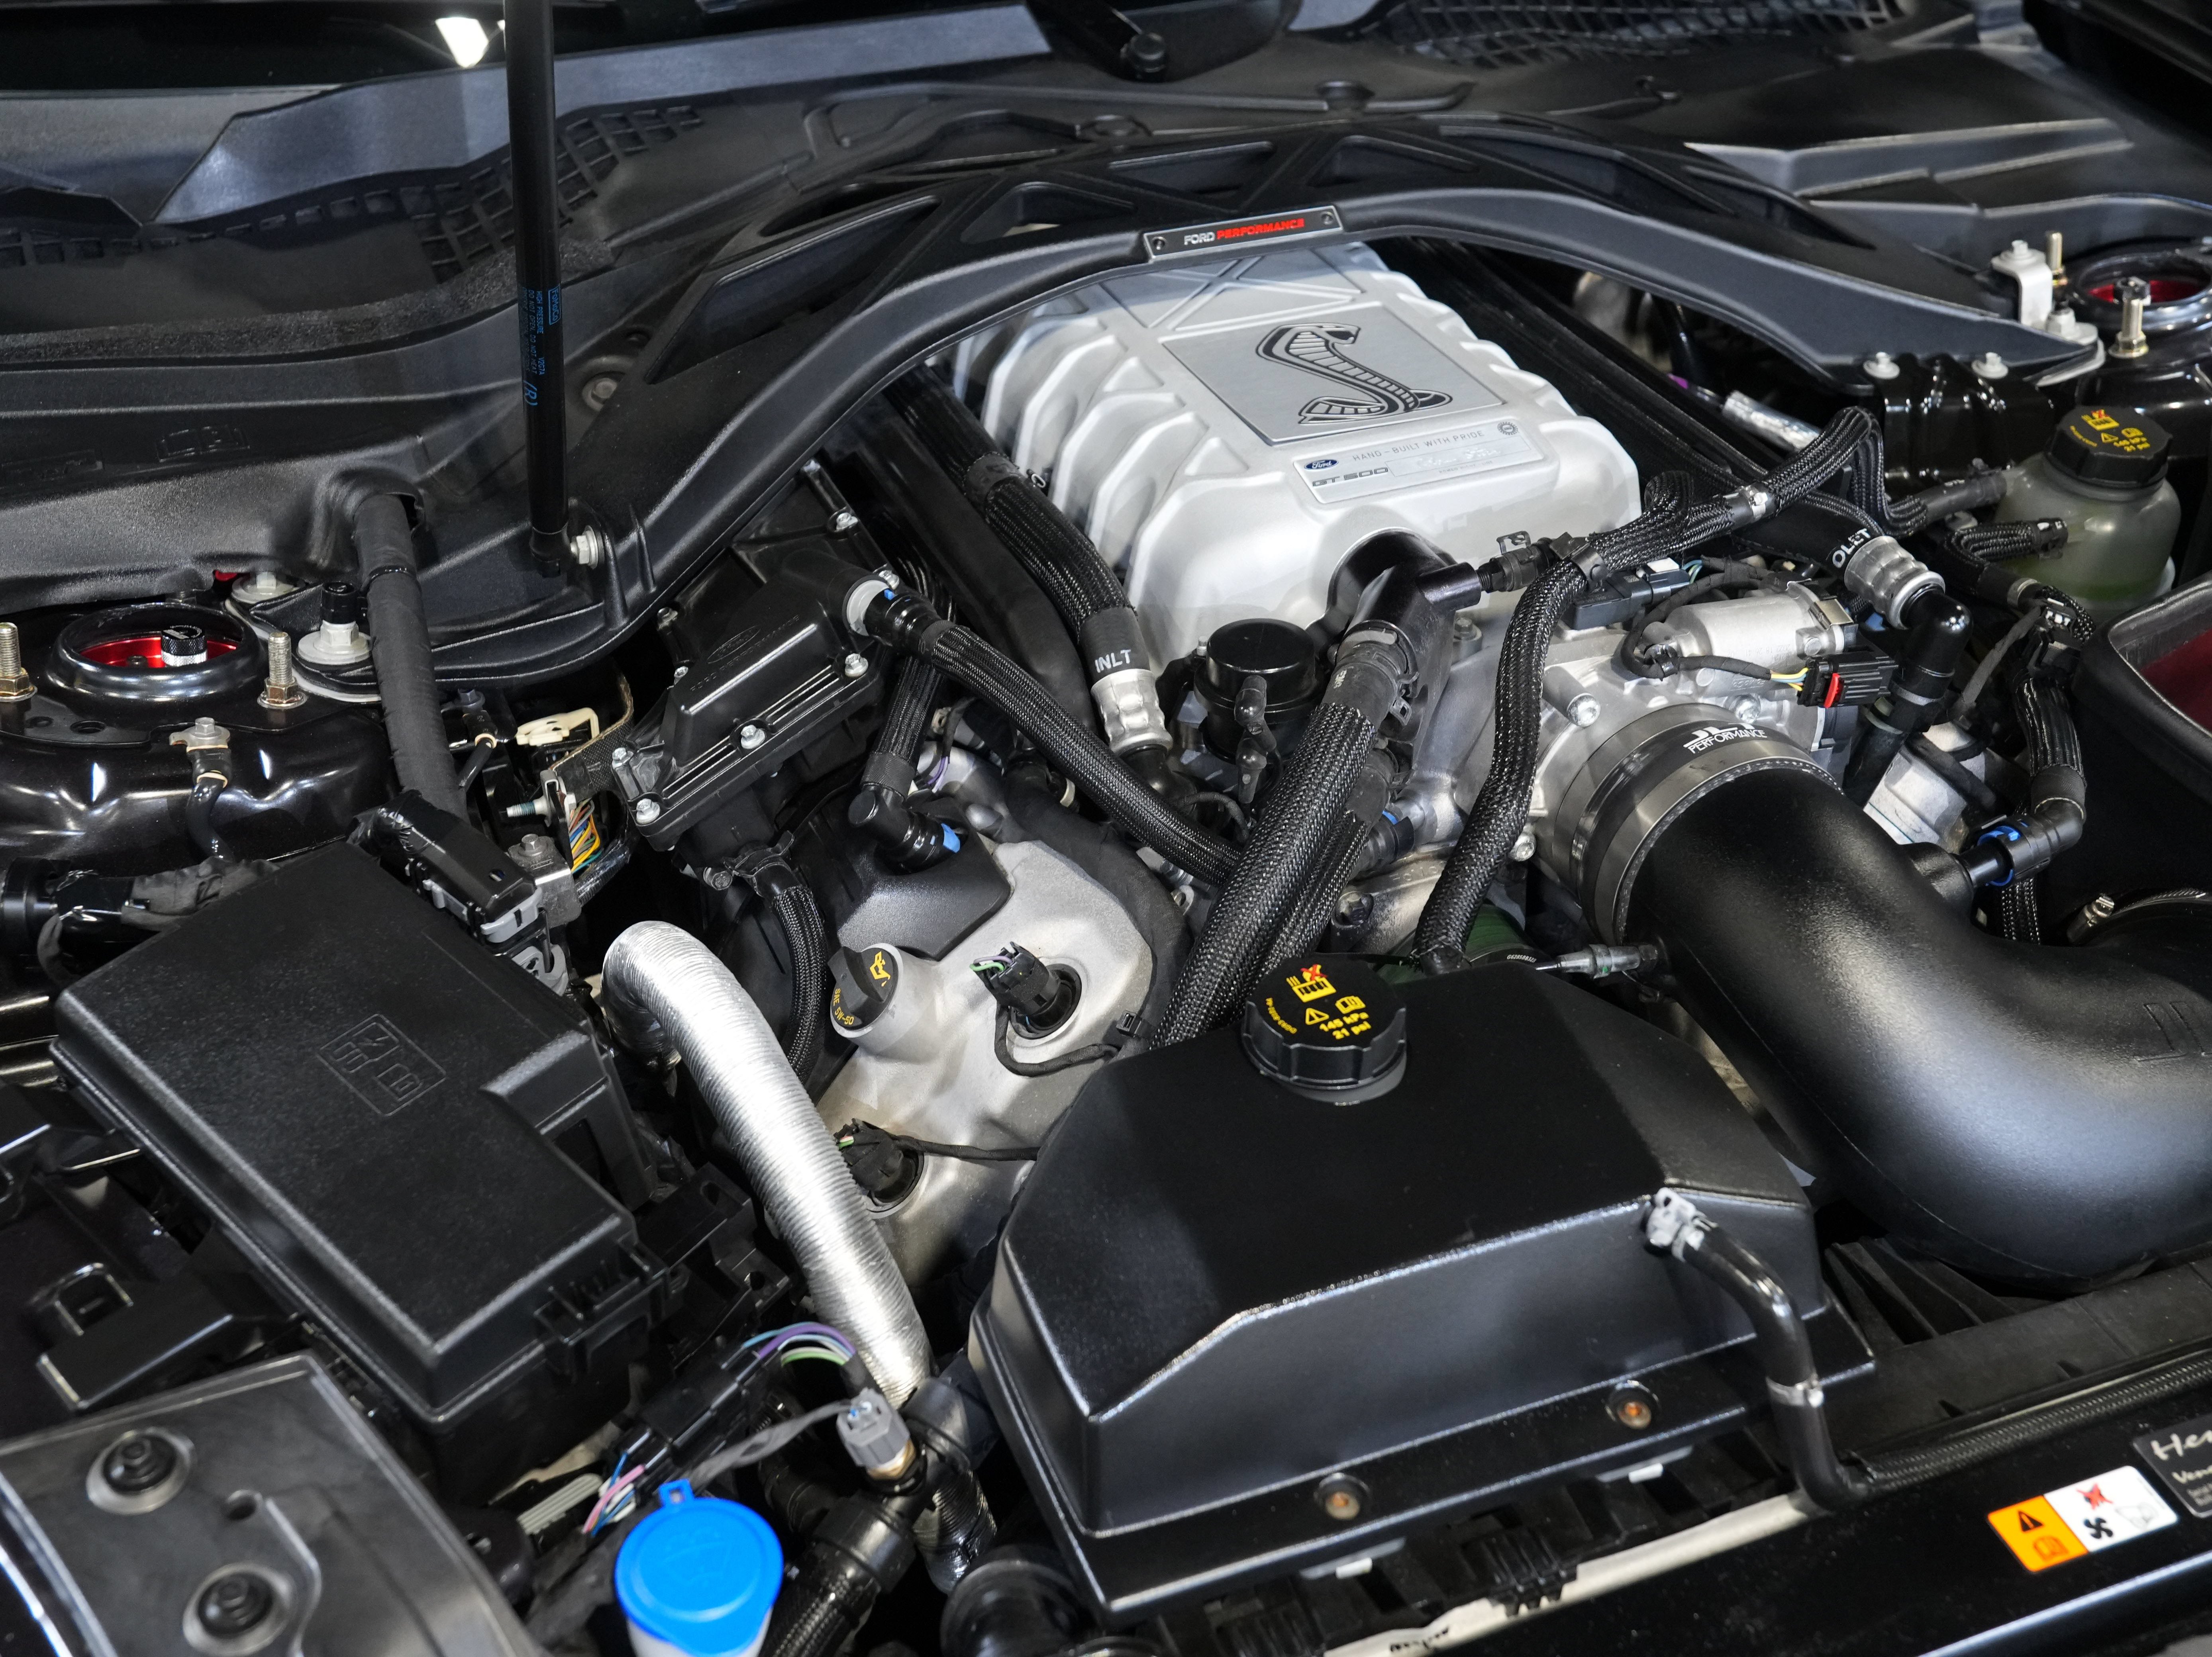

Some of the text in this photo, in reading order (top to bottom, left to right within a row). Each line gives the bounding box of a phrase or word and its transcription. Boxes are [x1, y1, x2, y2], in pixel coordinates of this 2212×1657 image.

[1184, 218, 1305, 245] FORD PERFORMANCE
[1424, 437, 1450, 447] WITH
[1453, 430, 1485, 442] PRIDE
[1308, 459, 1336, 470] Ford
[1313, 466, 1388, 487] GT 500
[1094, 649, 1131, 673] INLT
[1687, 729, 1767, 754] PERFORMANCE
[833, 988, 841, 1007] SAE
[834, 1007, 855, 1025] 5W-50
[1319, 1012, 1369, 1032] 145 kPa
[1332, 1021, 1372, 1040] 21 psi
